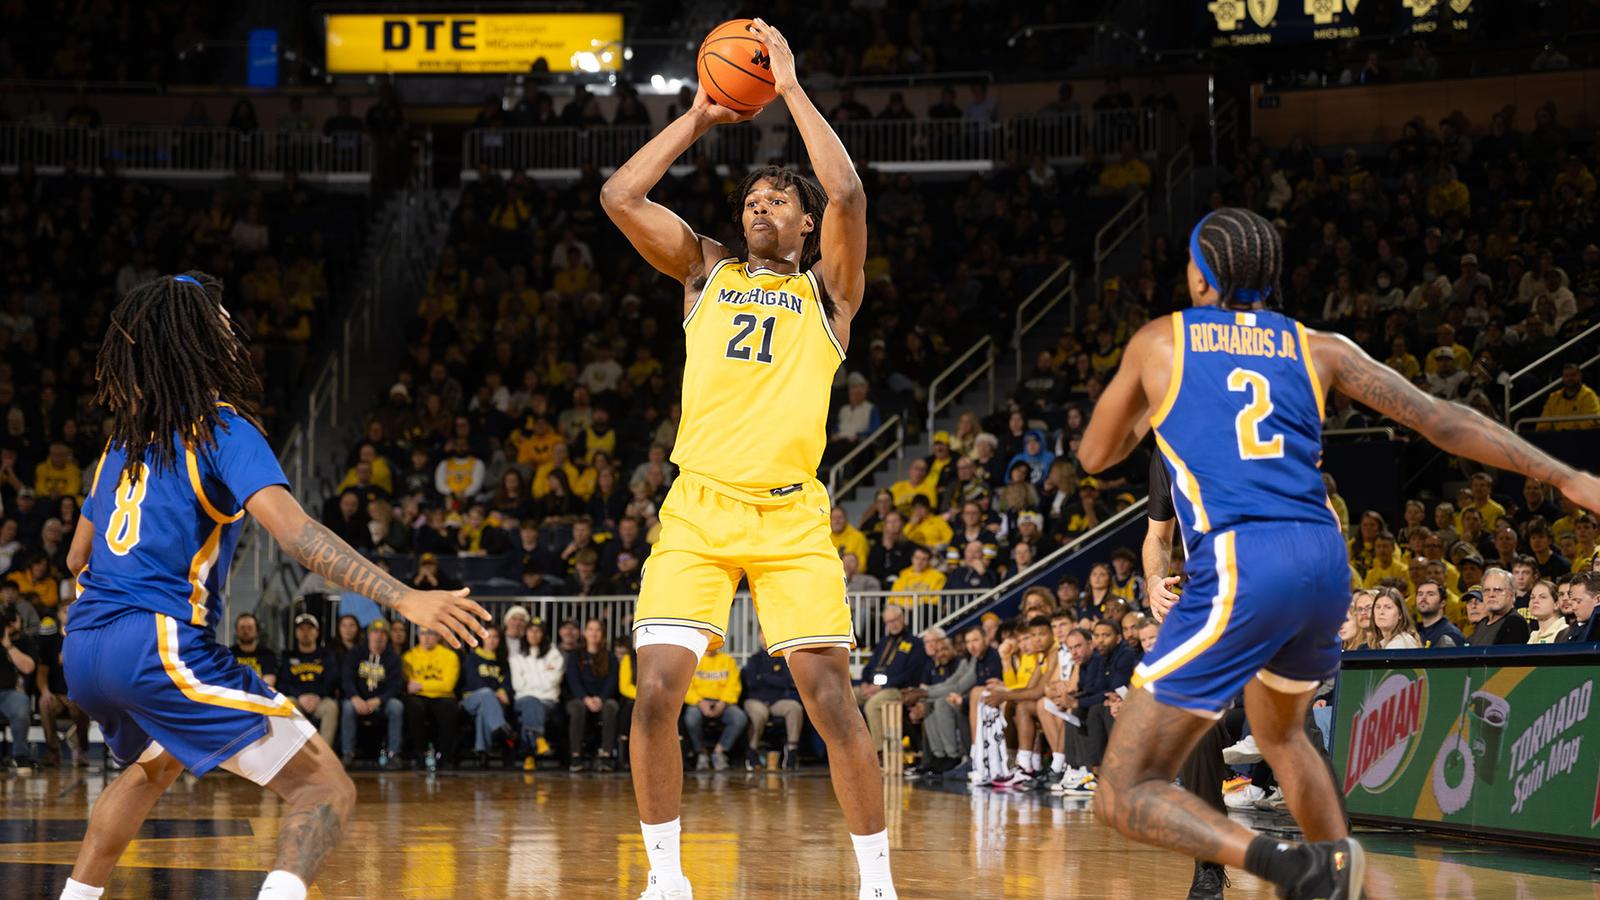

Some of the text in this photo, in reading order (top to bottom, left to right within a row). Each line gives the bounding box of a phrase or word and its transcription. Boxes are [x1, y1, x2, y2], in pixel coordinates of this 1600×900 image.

[383, 20, 477, 51] DTE
[717, 287, 802, 314] MICHIGAN
[724, 313, 776, 363] 21
[1190, 322, 1275, 358] RICHARDS
[1227, 367, 1285, 460] 2
[105, 462, 150, 556] 8
[1343, 675, 1425, 798] LIBMAN
[1508, 680, 1593, 781] TORNADO
[1510, 760, 1546, 814] Spin
[1546, 736, 1581, 782] Mop
